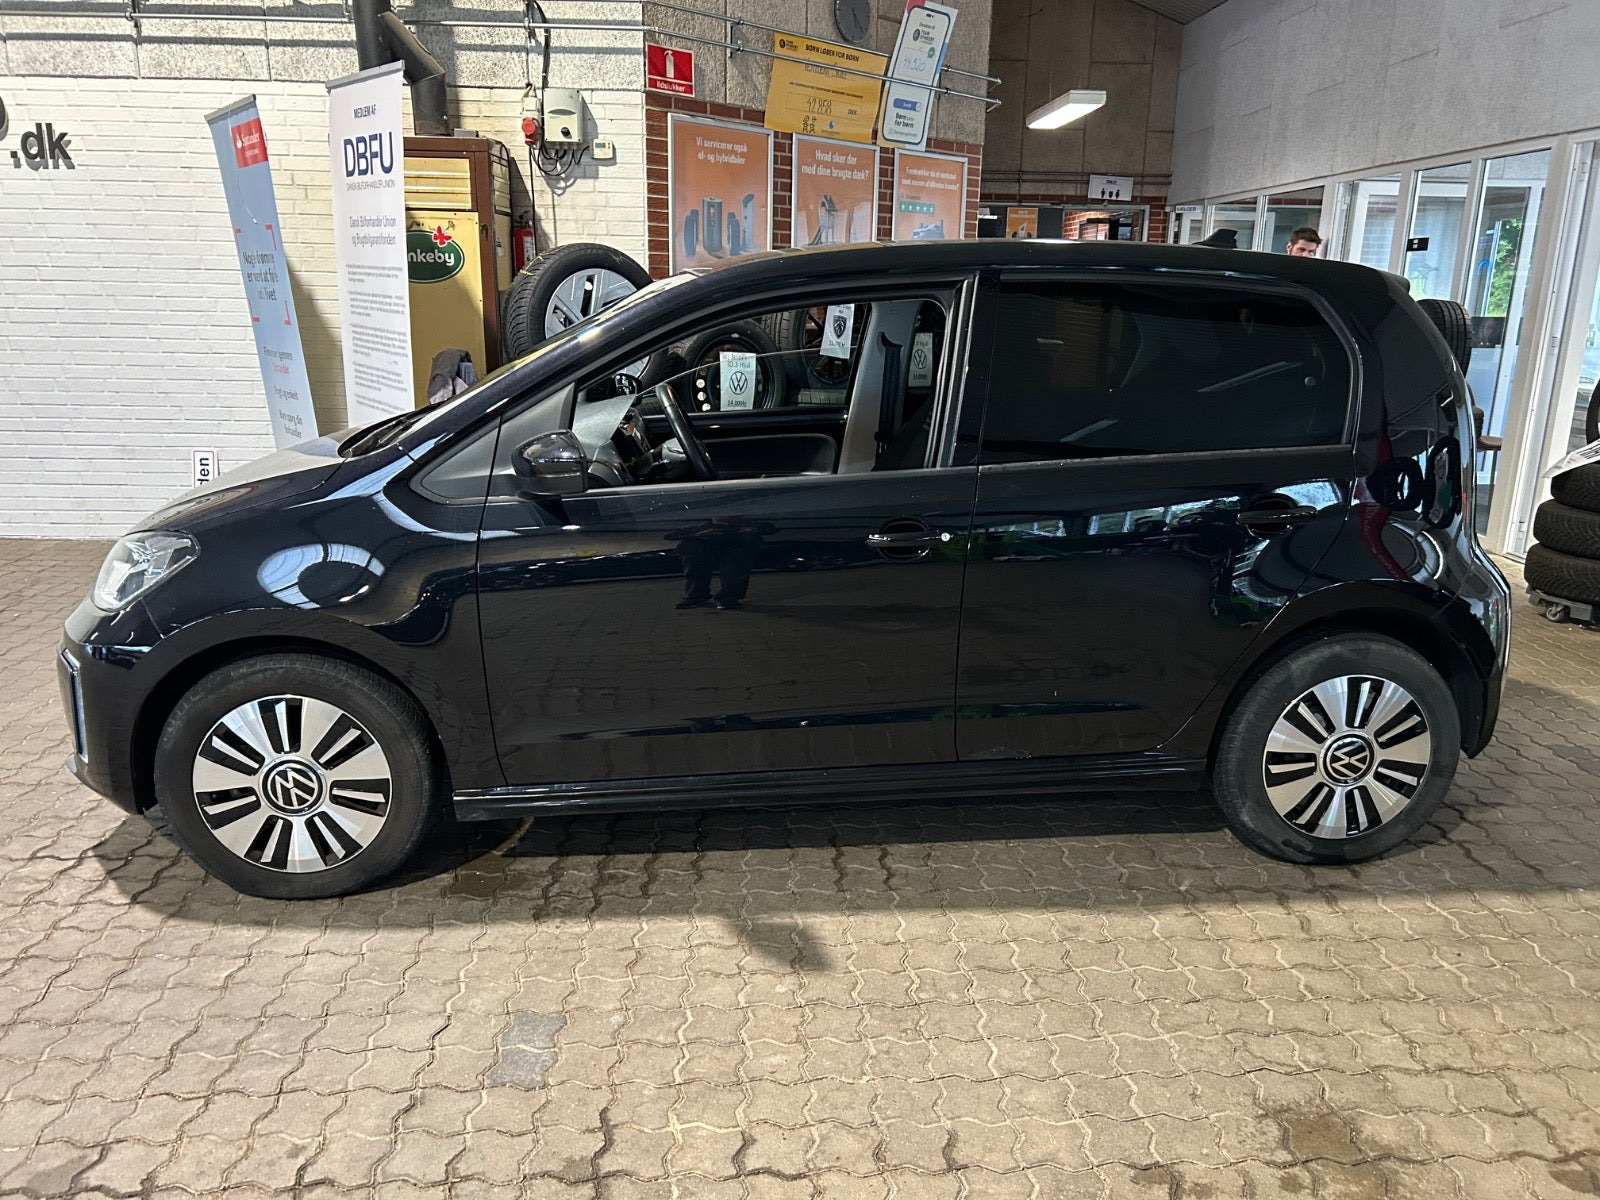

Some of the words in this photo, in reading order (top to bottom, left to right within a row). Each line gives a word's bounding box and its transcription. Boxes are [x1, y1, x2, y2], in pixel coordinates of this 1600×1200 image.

[805, 43, 820, 53] BØRN
[820, 46, 836, 57] LØBER
[836, 50, 845, 59] FOR
[845, 53, 860, 62] BØRN
[353, 105, 371, 119] MEDLEM
[371, 103, 377, 116] AF
[895, 112, 907, 120] Børn
[894, 119, 902, 127] for
[902, 121, 914, 129] børn
[10, 122, 72, 161] .dk
[696, 136, 703, 146] Vi
[704, 139, 733, 150] servicerer
[733, 142, 748, 154] også
[343, 131, 394, 178] DBFU
[707, 153, 715, 164] og
[716, 152, 746, 165] hybridbiler
[815, 149, 832, 162] Hvad
[832, 152, 846, 164] sker
[846, 153, 857, 165] der
[801, 164, 816, 175] med
[817, 165, 831, 176] dine
[831, 166, 852, 180] brugte
[852, 169, 869, 180] dæk?
[383, 215, 397, 227] Union
